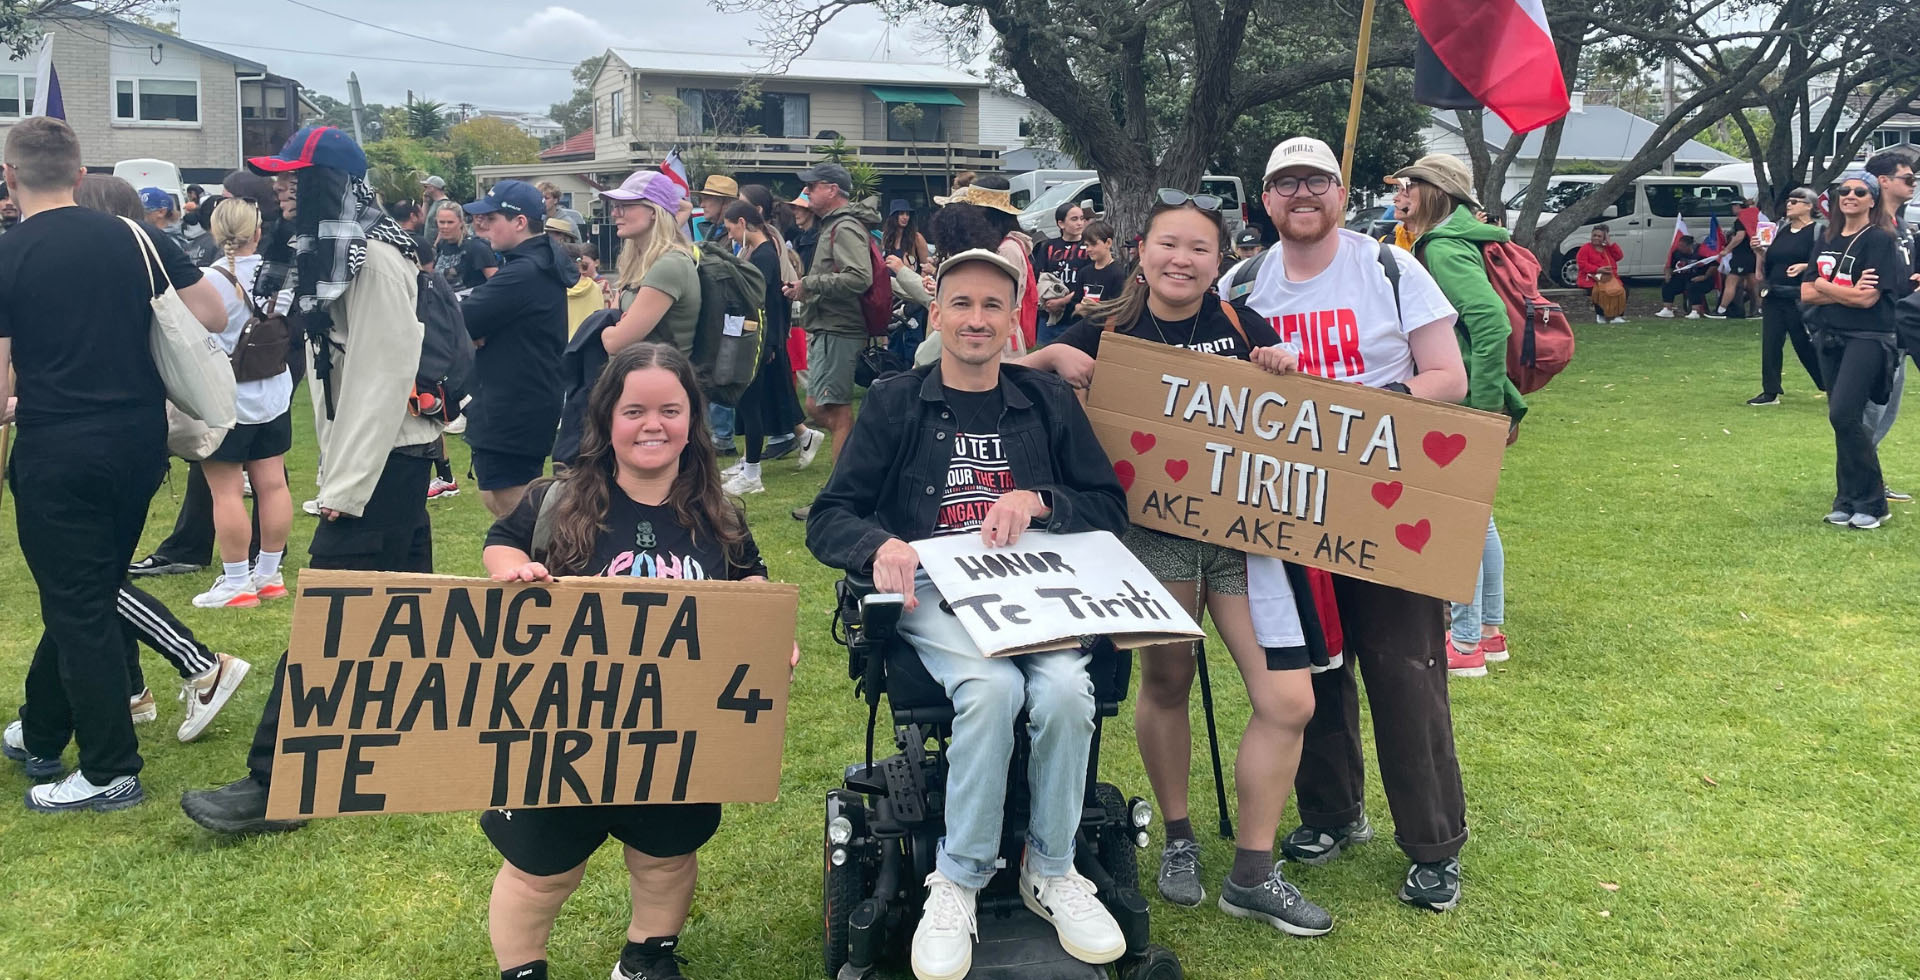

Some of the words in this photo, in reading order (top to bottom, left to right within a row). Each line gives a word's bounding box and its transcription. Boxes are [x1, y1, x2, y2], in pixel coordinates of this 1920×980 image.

[968, 438, 989, 459] TE
[992, 439, 1006, 459] T
[1162, 374, 1402, 470] TANGATA
[945, 468, 974, 487] OUR
[973, 470, 996, 488] THE
[998, 471, 1017, 489] TR
[1205, 442, 1328, 526] TIRITI
[954, 551, 1076, 581] HONOR
[1142, 490, 1209, 536] AKE,
[1225, 516, 1300, 556] AKE,
[1314, 533, 1378, 571] AKE
[303, 587, 701, 660] TĀNGATA
[952, 593, 1032, 632] Te
[1035, 579, 1171, 620] Tiriti
[288, 660, 663, 731] WHAIKAHA
[717, 664, 774, 723] 4
[282, 733, 401, 814] TE
[478, 730, 697, 806] TIRITI
